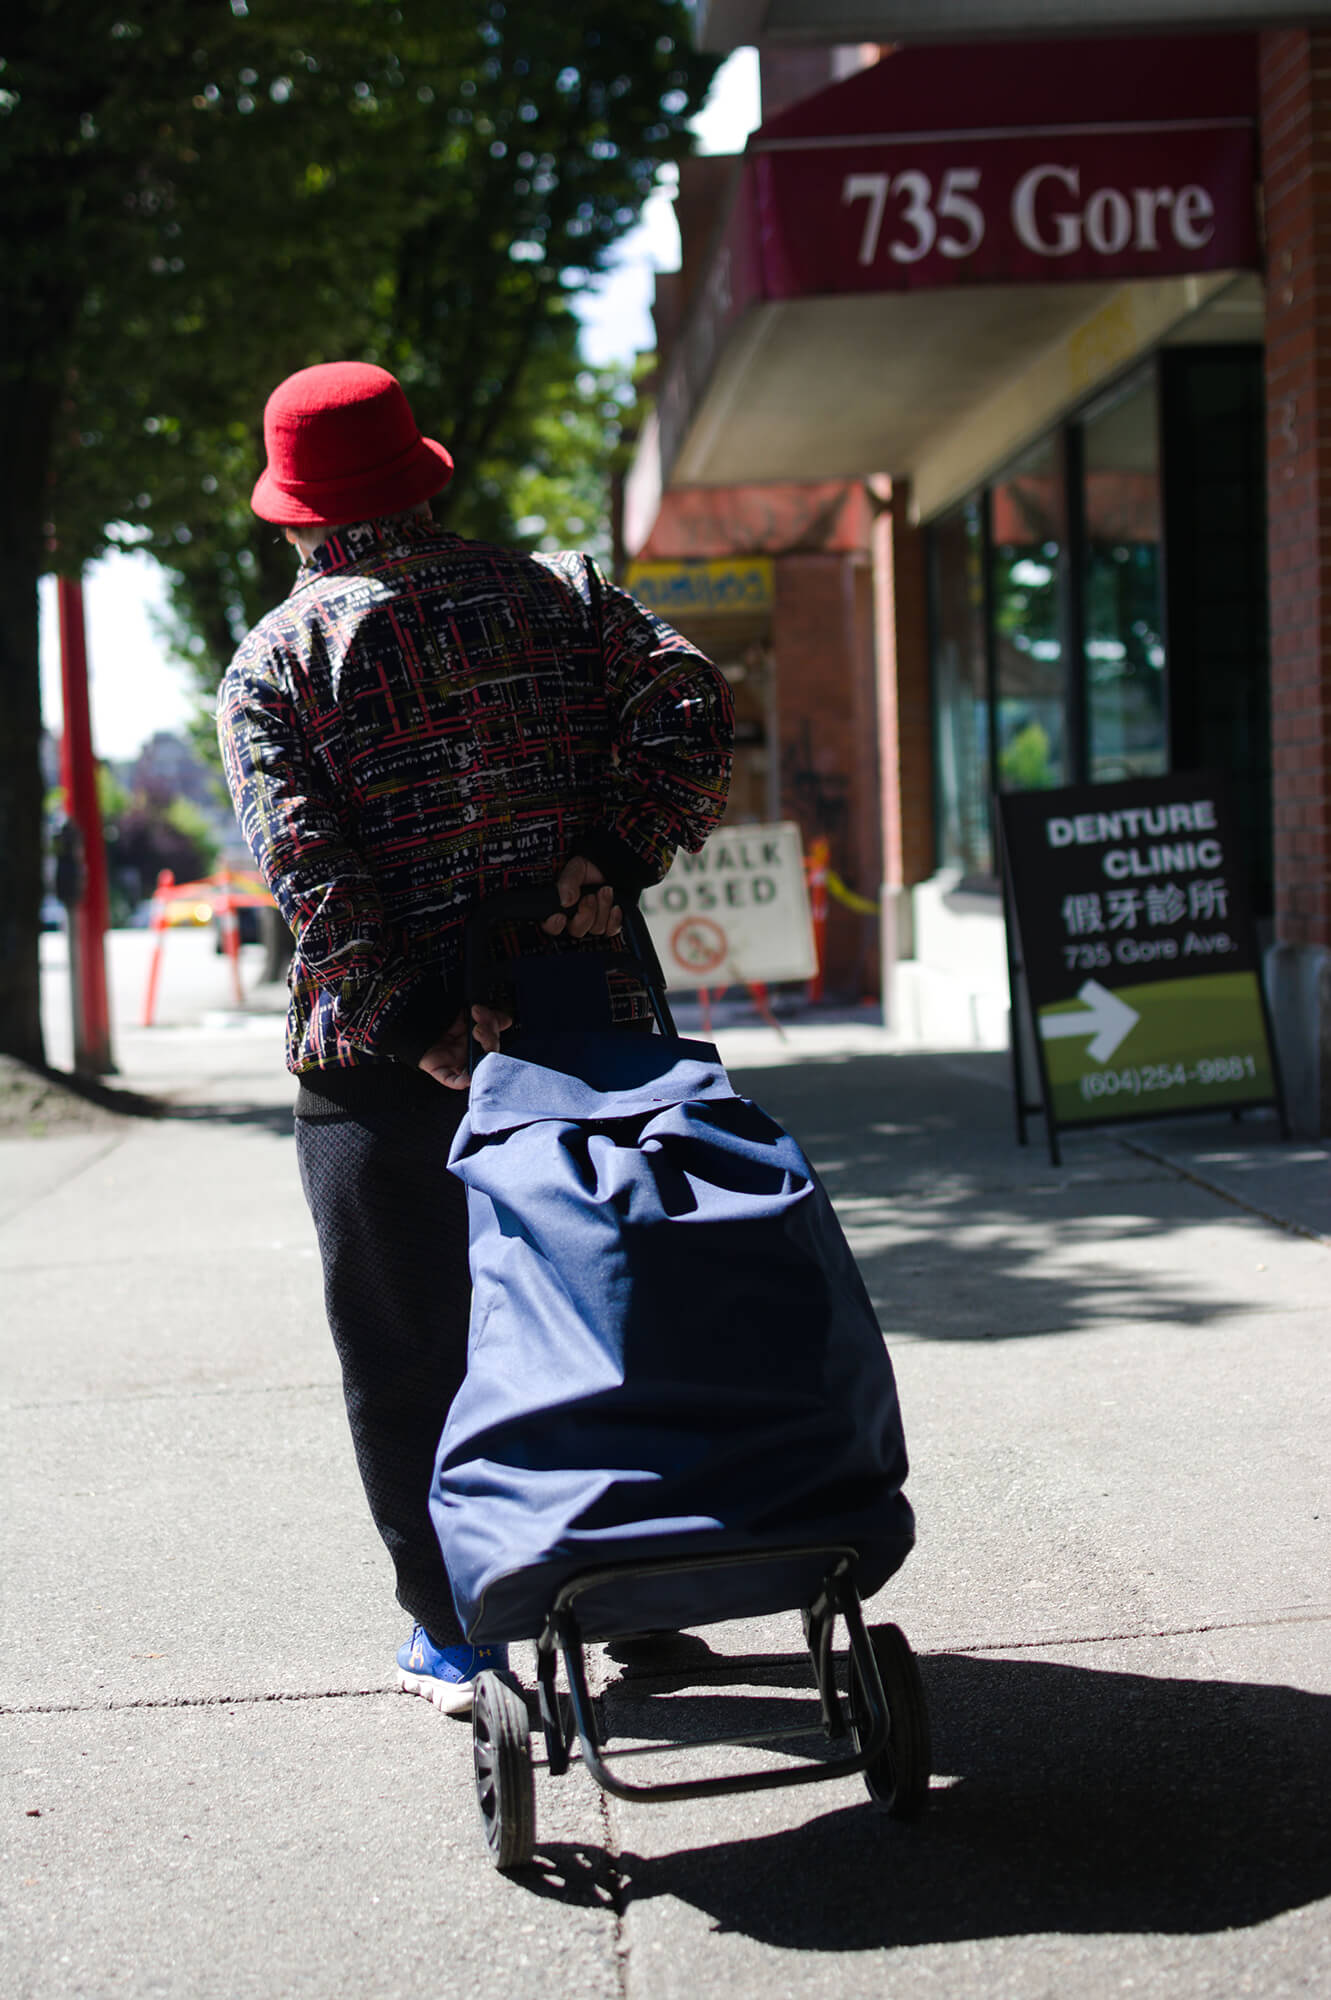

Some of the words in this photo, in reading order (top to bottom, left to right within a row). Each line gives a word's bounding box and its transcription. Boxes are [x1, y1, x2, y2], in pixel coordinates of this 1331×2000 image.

[842, 166, 986, 266] 735
[1011, 164, 1215, 257] Gore
[1047, 801, 1217, 847] DENTURE
[666, 841, 783, 880] WALK
[1103, 839, 1223, 879] CLINIC
[1062, 879, 1229, 936] 假牙診所
[1064, 942, 1112, 970] 735
[1115, 938, 1179, 964] Gore
[1182, 931, 1239, 956] Ave.
